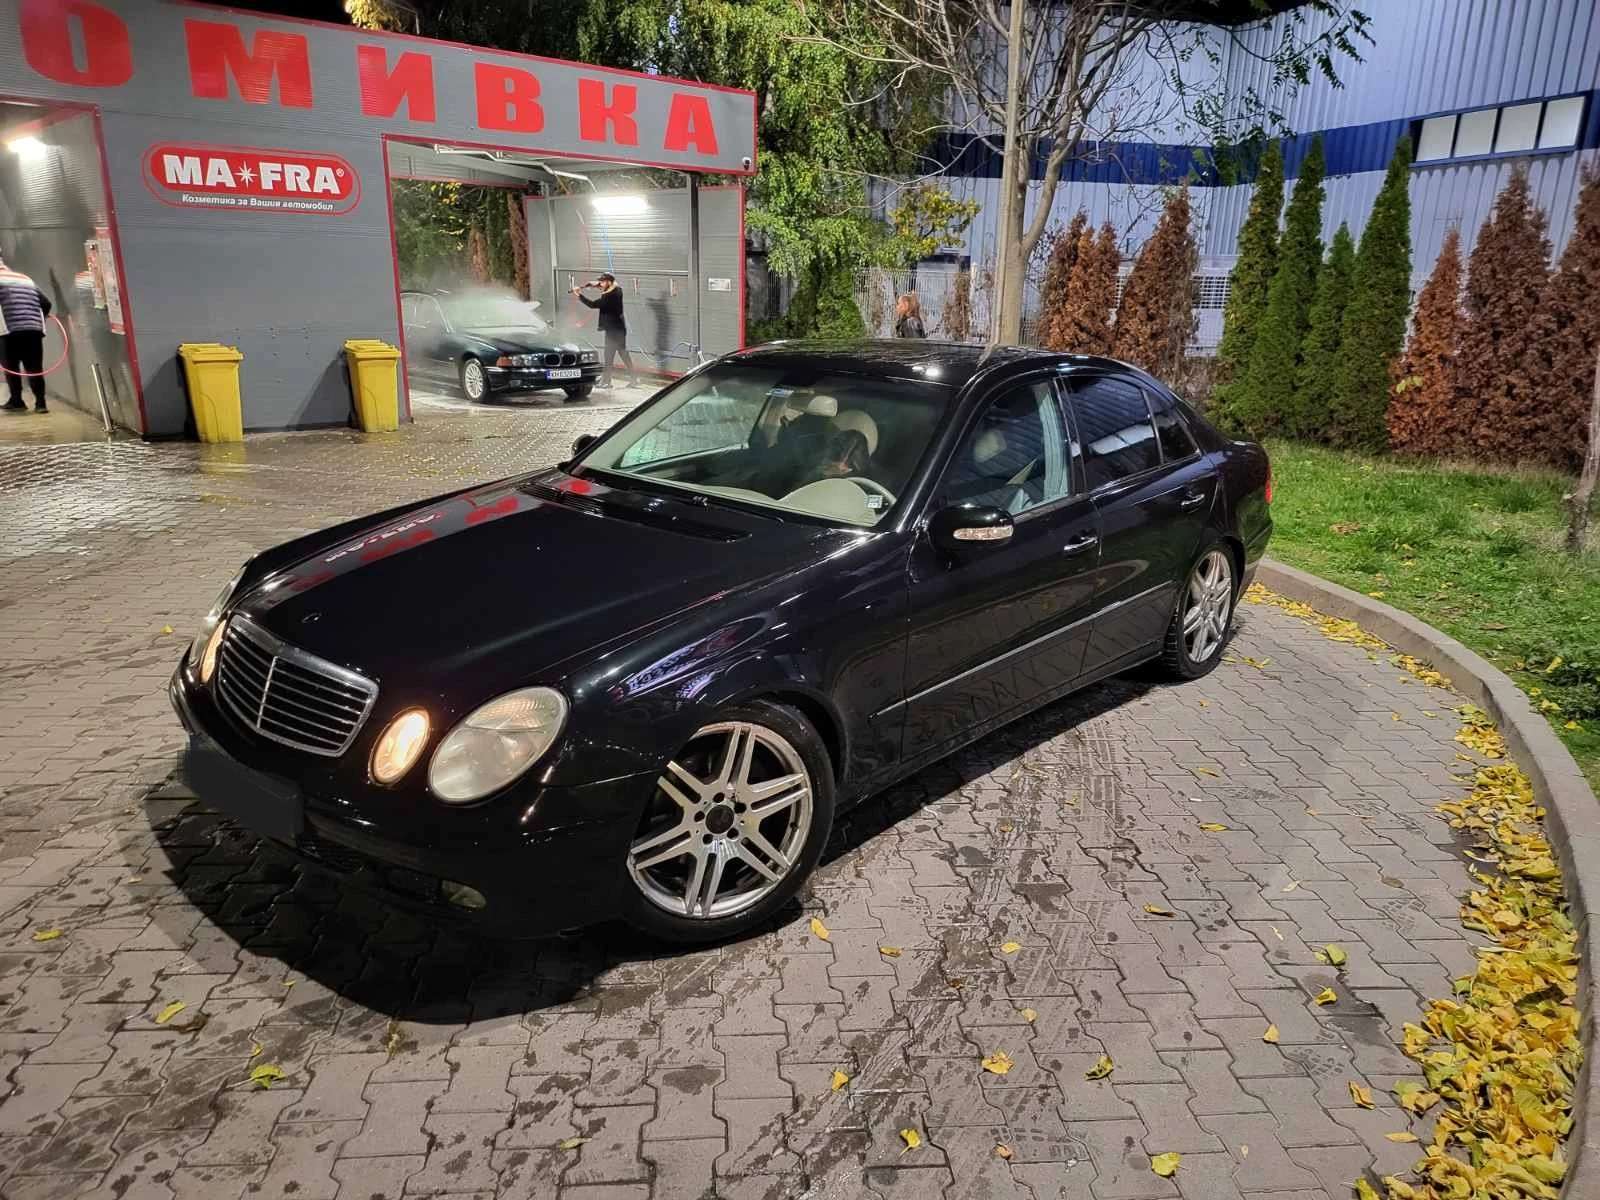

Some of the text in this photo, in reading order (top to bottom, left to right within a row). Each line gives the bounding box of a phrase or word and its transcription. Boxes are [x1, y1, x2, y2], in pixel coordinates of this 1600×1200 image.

[182, 194, 236, 206] Козметика
[250, 198, 281, 208] Вашия
[282, 200, 334, 211] автомобил
